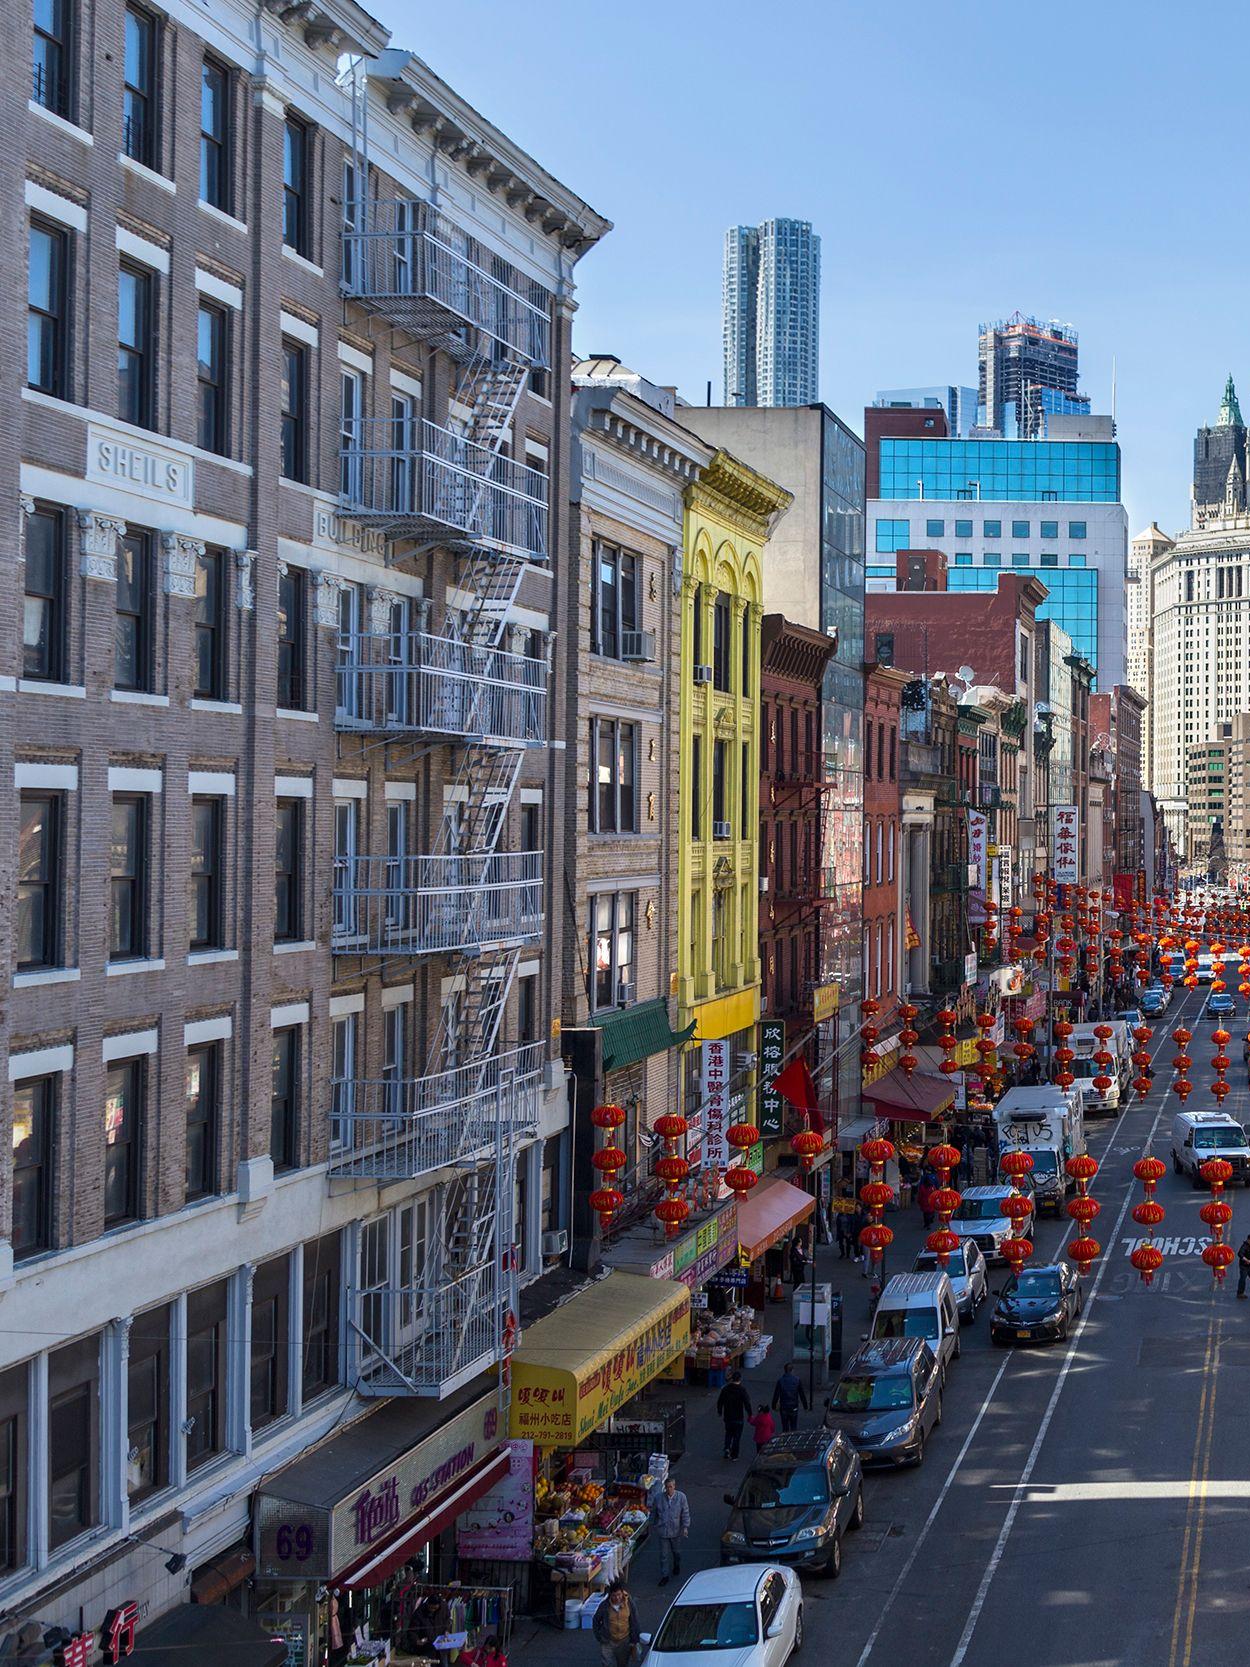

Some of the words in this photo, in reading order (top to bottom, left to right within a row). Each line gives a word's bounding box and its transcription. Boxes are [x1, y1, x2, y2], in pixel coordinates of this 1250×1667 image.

[99, 441, 178, 492] SHEILS
[518, 1412, 572, 1426] 福州小吃店
[521, 1431, 573, 1441] 212-791-2819
[277, 1524, 314, 1561] 69
